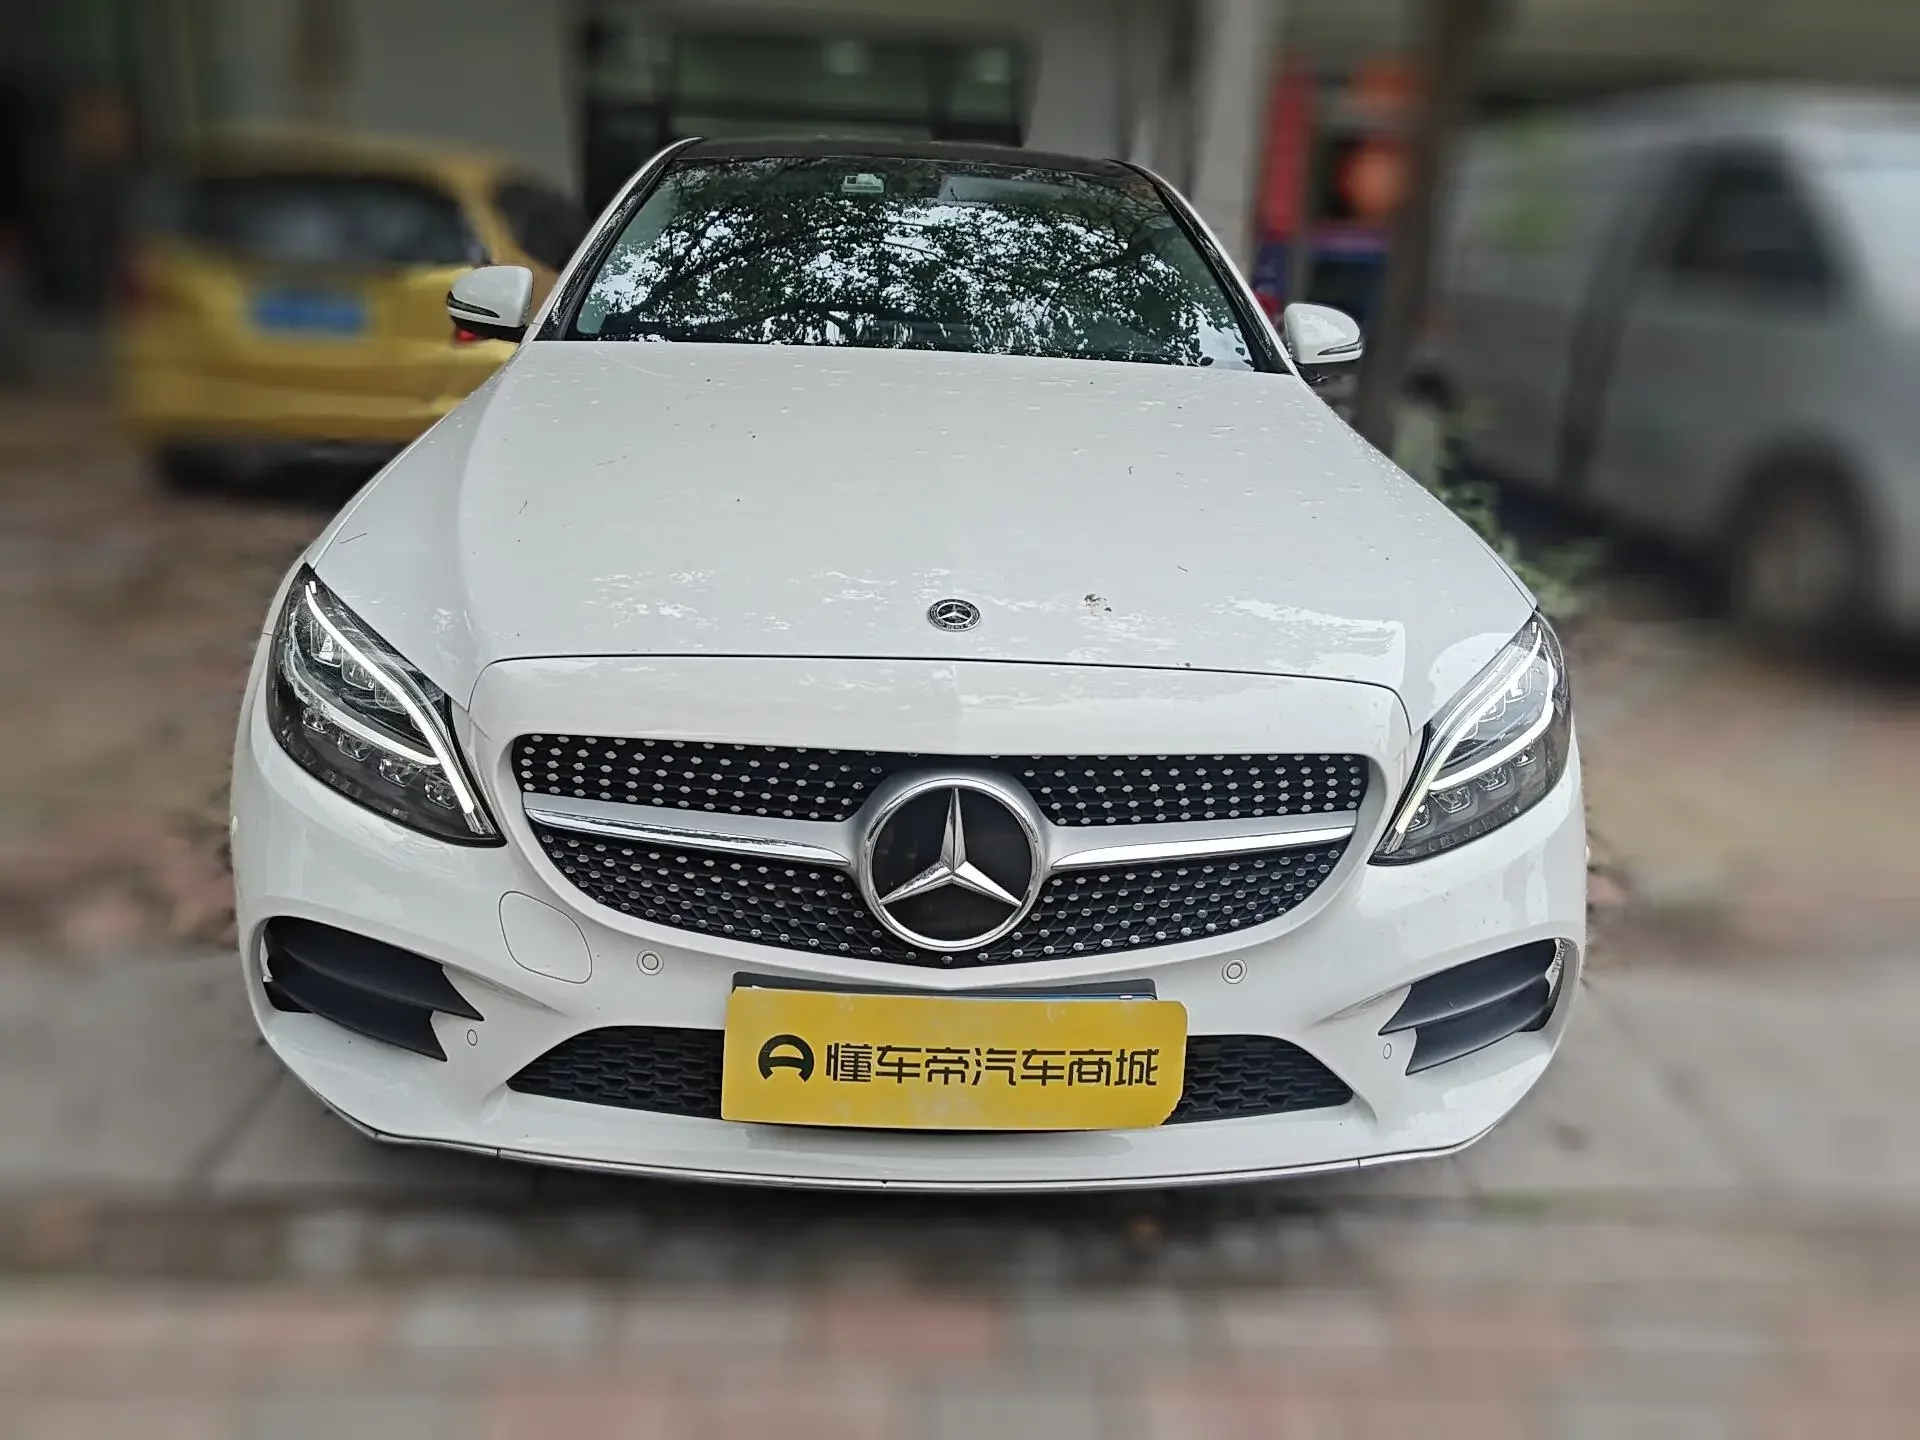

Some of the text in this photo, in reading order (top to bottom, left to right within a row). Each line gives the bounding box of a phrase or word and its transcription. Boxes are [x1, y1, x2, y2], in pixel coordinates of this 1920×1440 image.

[825, 1042, 1160, 1087] 懂车帝汽车商城
